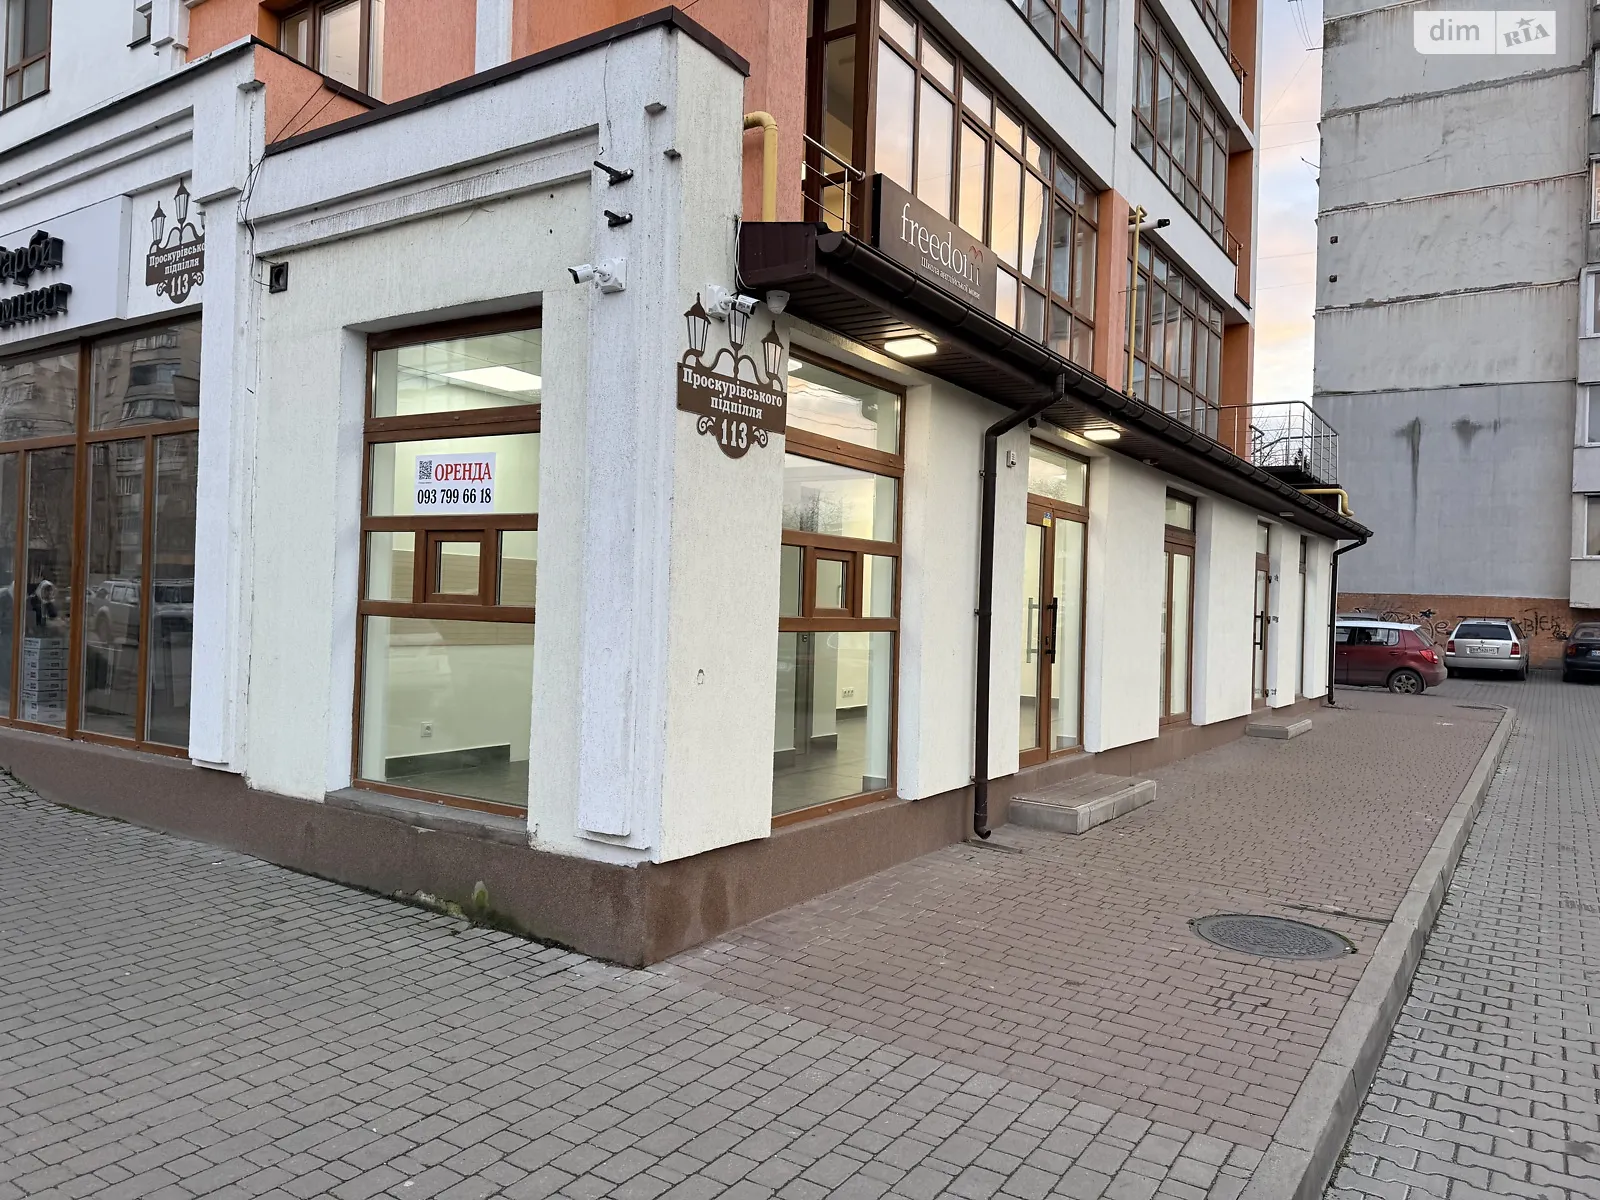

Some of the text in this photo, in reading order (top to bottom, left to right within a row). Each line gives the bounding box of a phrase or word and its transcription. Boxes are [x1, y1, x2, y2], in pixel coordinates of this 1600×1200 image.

[900, 202, 983, 287] freedom
[0, 229, 63, 288] арби
[164, 257, 199, 275] підпілля
[921, 256, 940, 276] Школа
[171, 273, 189, 297] 113
[0, 283, 72, 328] мінат
[683, 367, 783, 407] Проскурівського
[710, 393, 763, 420] підпілля
[721, 418, 748, 449] 113
[434, 462, 492, 483] ОРЕНДА
[417, 487, 492, 504] 093 799 66 18
